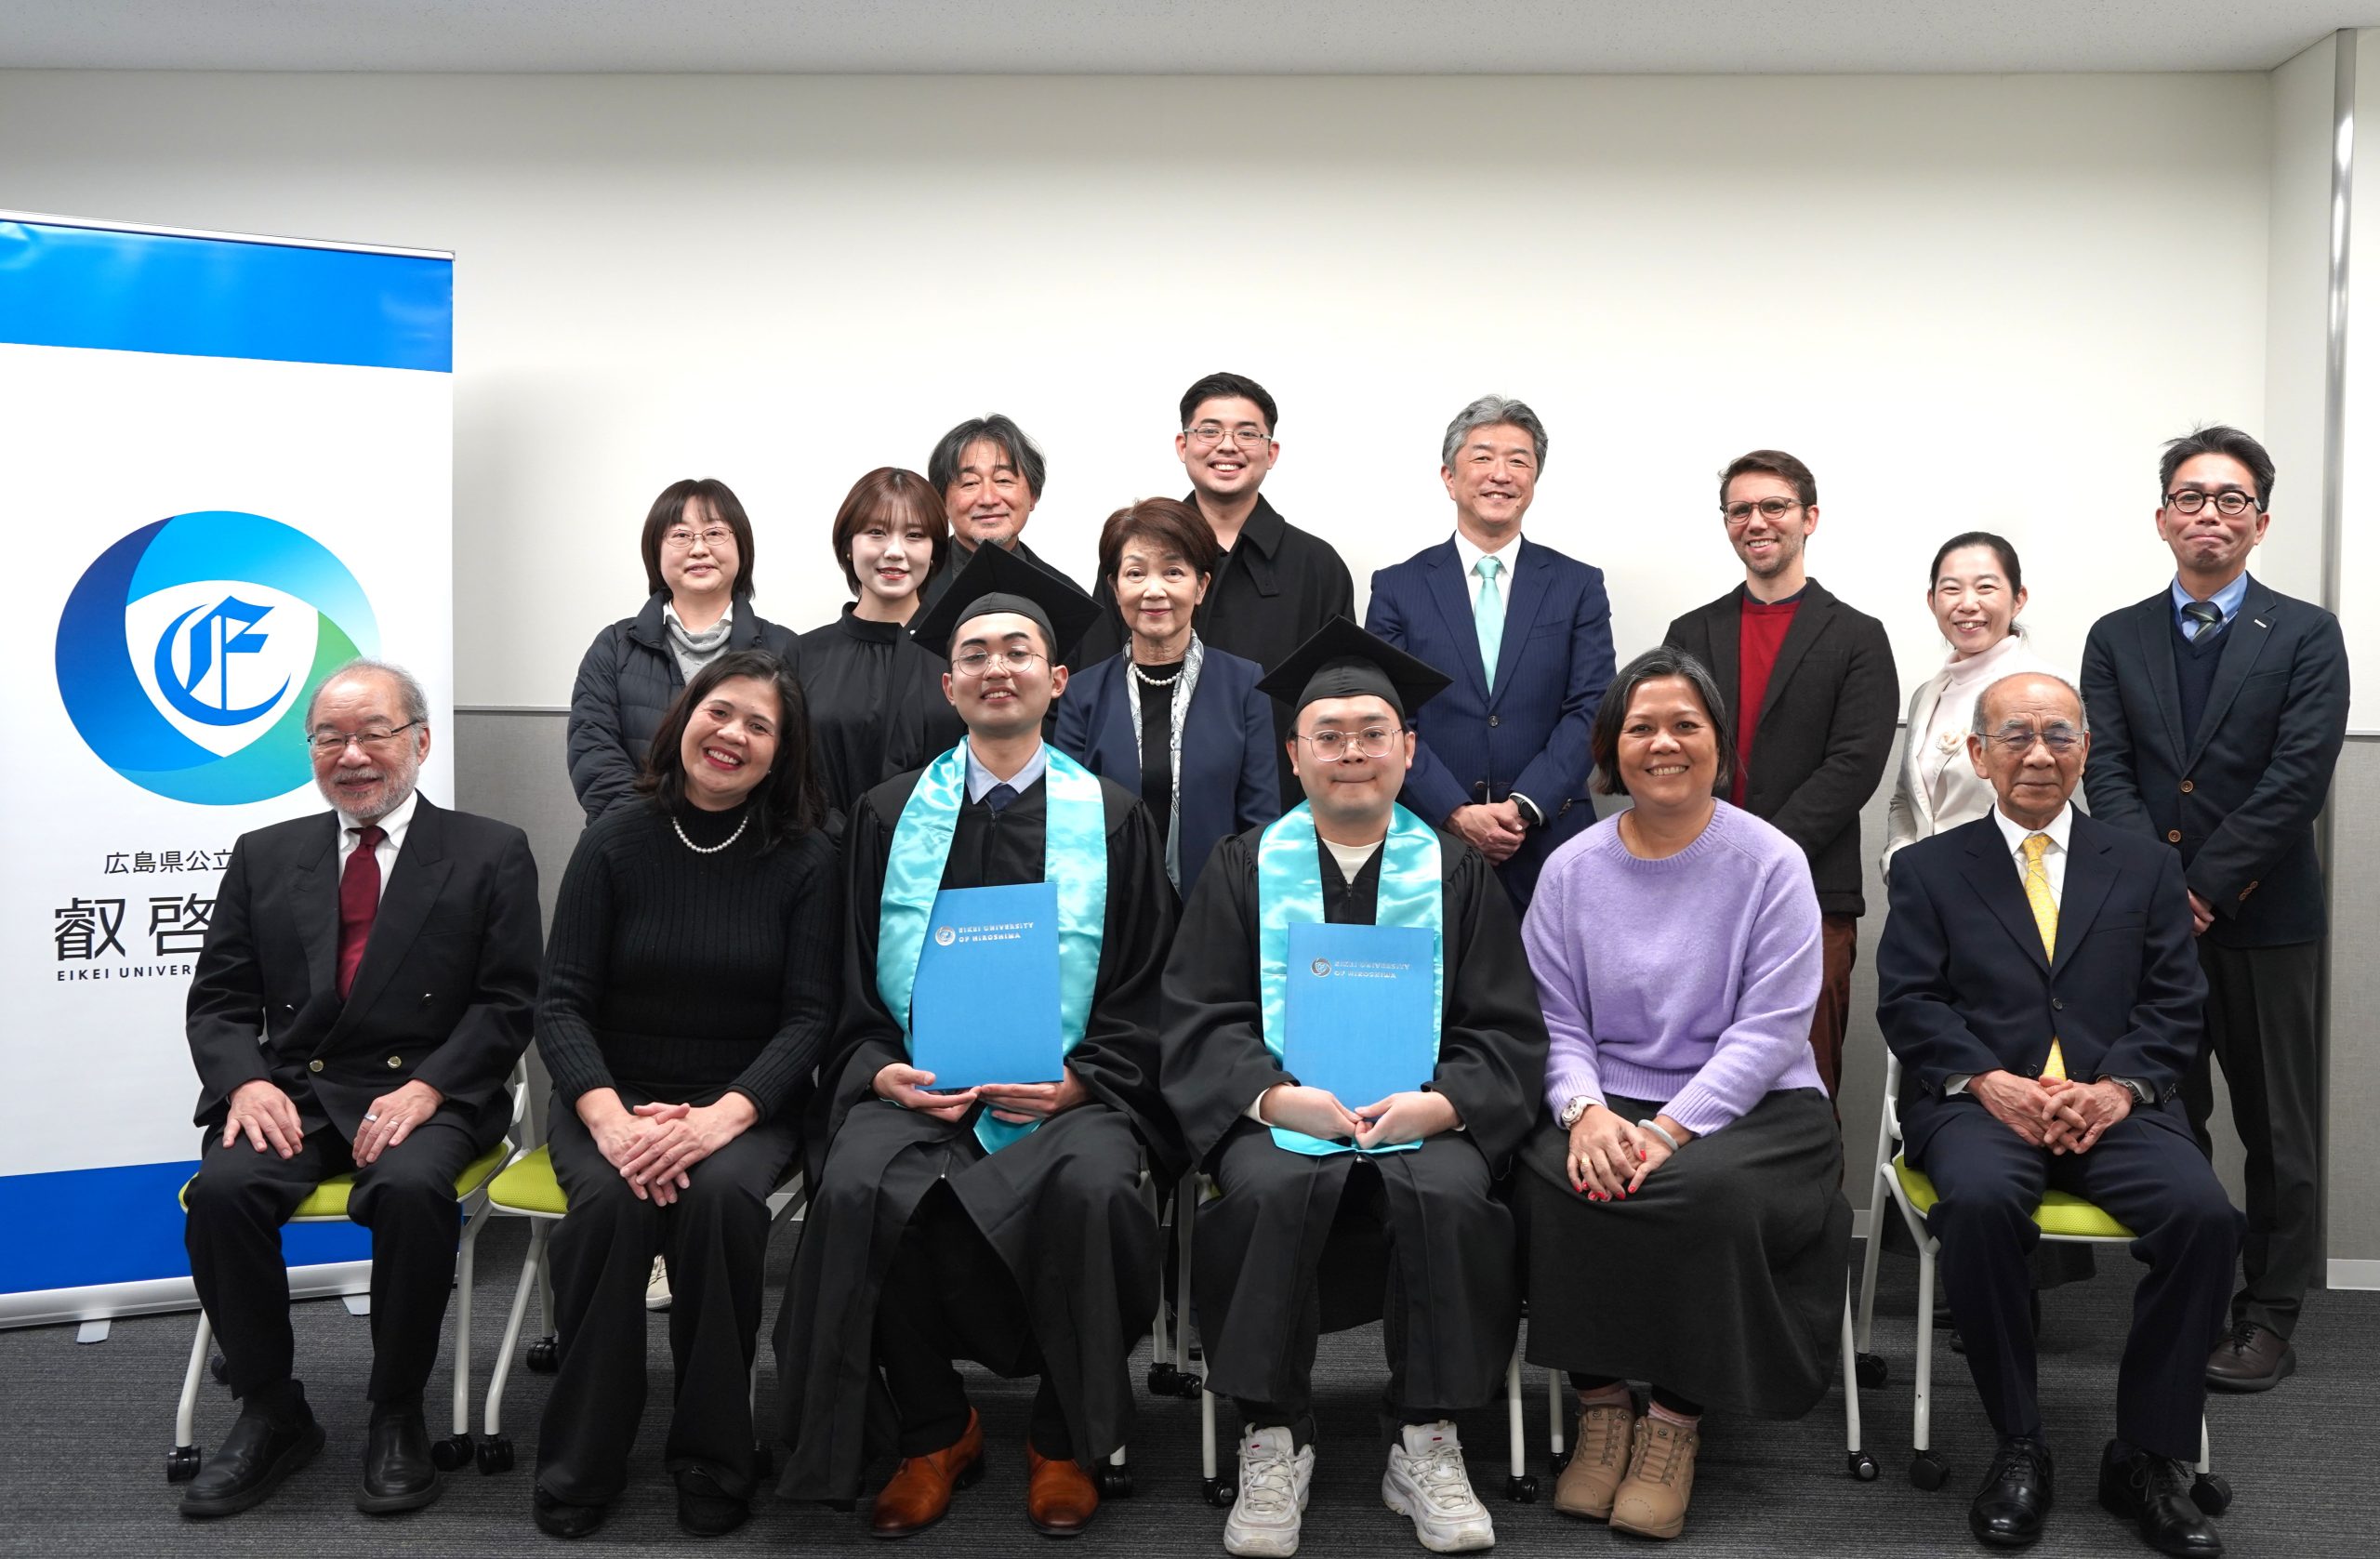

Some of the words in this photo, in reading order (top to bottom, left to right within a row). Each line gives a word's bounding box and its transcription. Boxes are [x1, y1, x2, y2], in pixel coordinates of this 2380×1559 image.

[104, 849, 232, 875] 広島県公立
[984, 922, 1034, 931] UNIVERSITY
[972, 932, 1021, 942] HIROSHIMA
[58, 968, 109, 982] EIKEI
[119, 964, 196, 978] UNIVER
